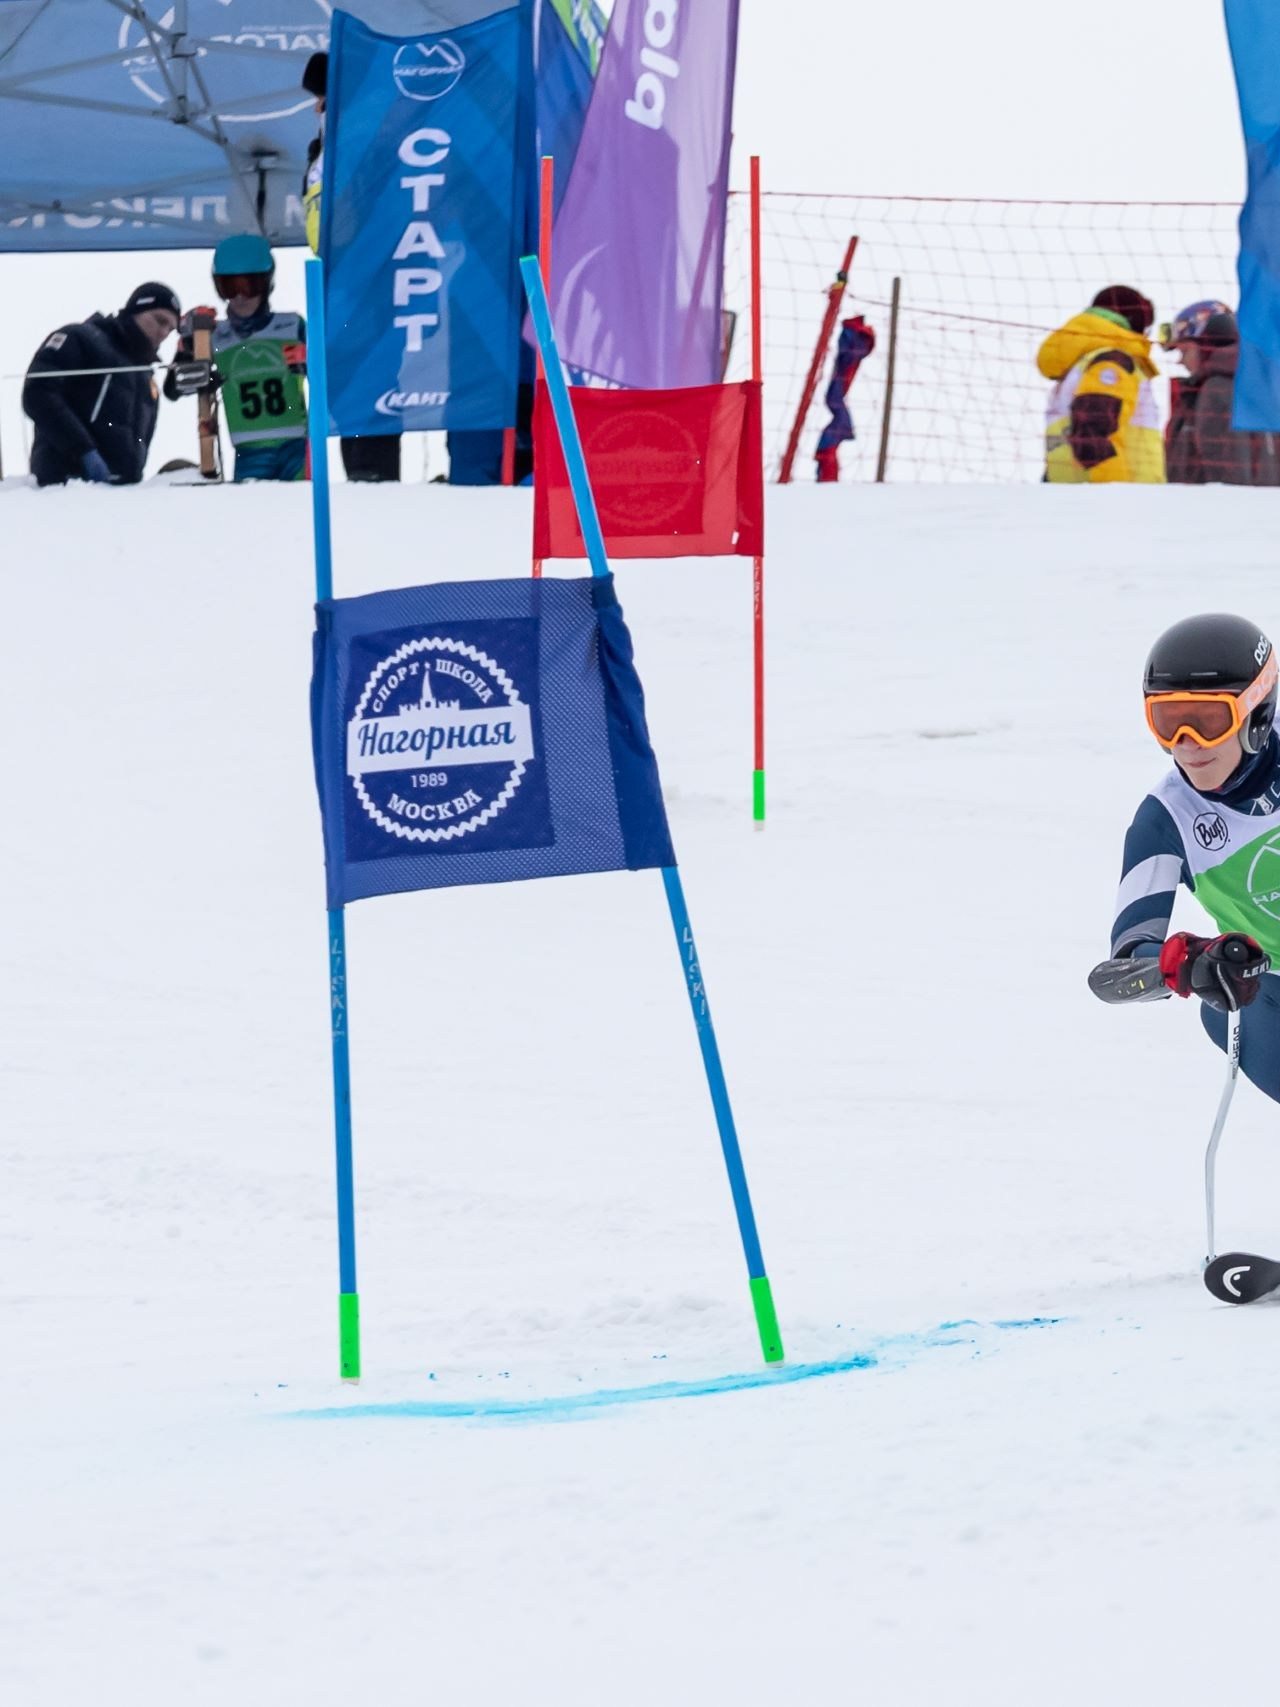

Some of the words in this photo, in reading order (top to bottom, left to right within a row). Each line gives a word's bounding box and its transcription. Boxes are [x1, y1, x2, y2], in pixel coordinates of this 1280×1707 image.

[392, 128, 451, 352] СТАРТ
[239, 378, 287, 420] 58
[372, 661, 420, 713] СПОРТ
[435, 658, 495, 704] ШКОЛА
[357, 721, 517, 761] Нагорная
[410, 772, 449, 788] 1989
[386, 789, 483, 821] МОСКВА
